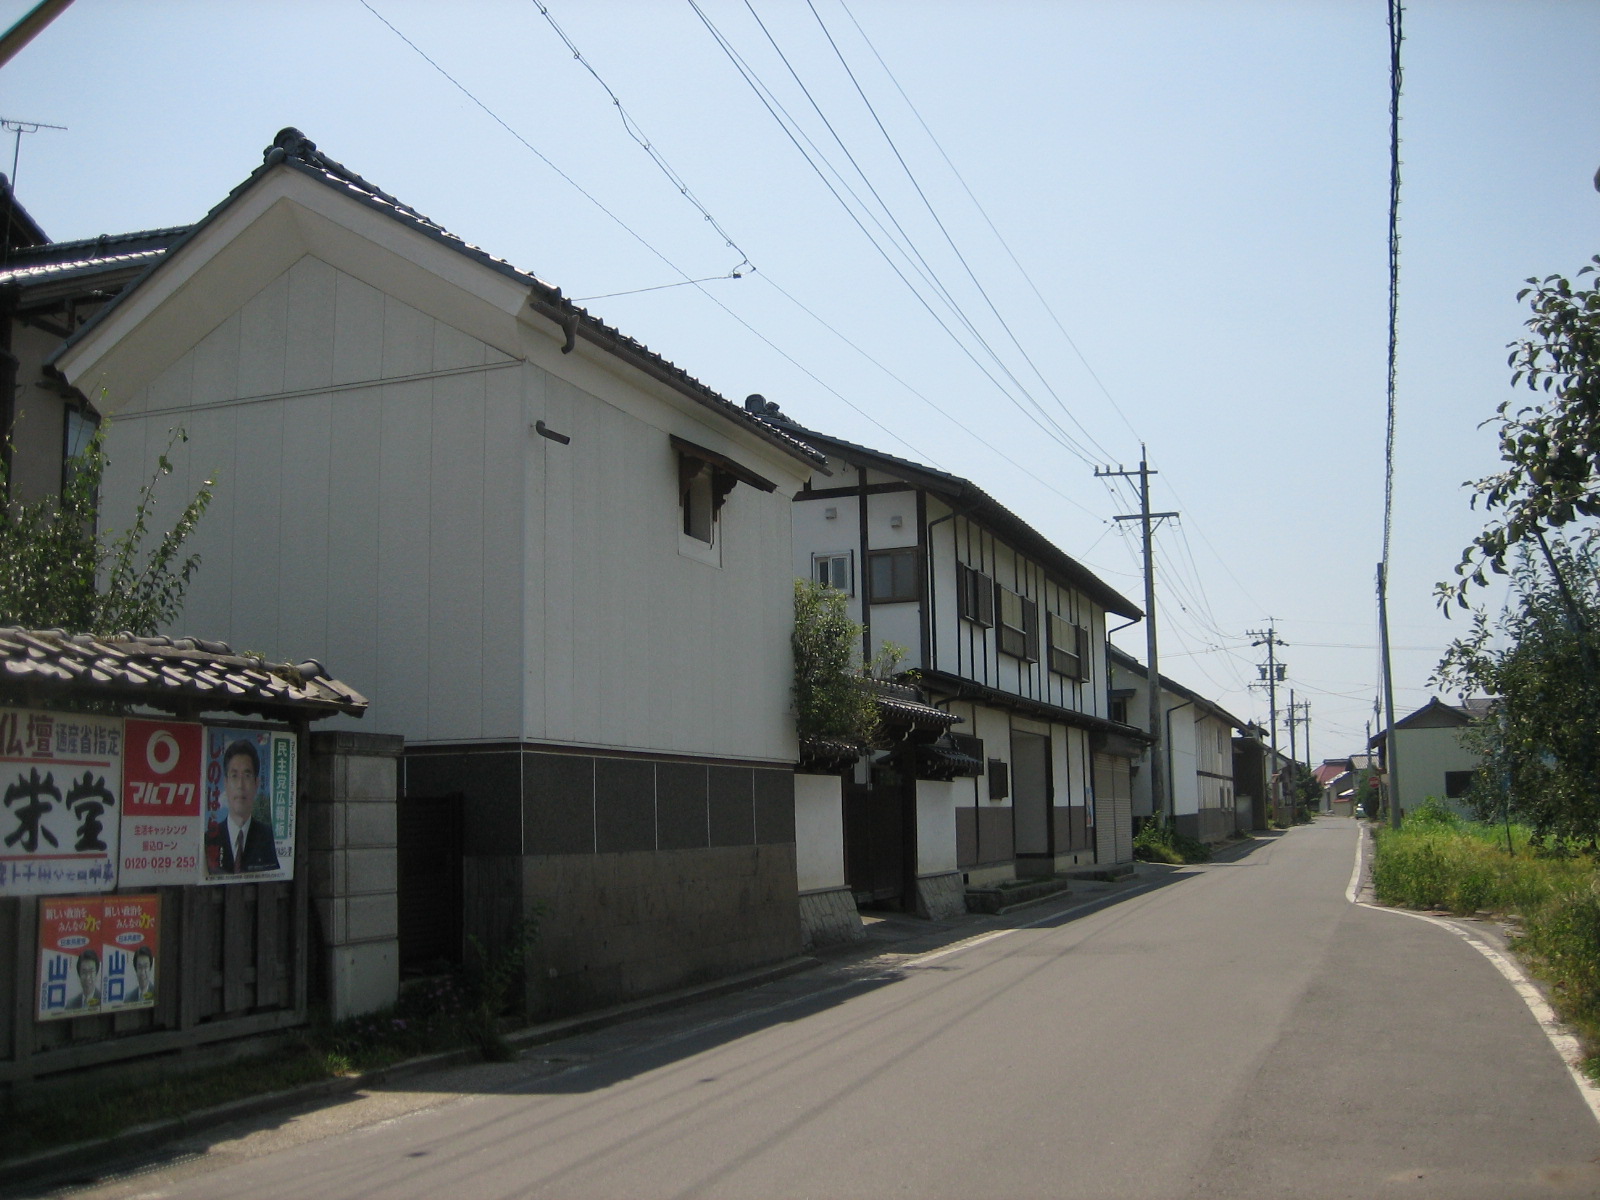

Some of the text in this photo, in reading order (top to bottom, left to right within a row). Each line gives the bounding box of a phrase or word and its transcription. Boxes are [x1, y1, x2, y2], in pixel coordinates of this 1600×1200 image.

[0, 713, 120, 757] 仏壇 通産省指定
[129, 782, 195, 805] マルフク
[276, 742, 288, 837] 民主党広報板
[134, 826, 187, 835] 生活キャッシング
[46, 908, 87, 919] 新しい政治を
[105, 905, 142, 917] 新しい政治を
[47, 955, 68, 1009] 山口
[108, 951, 126, 1002] 山口
